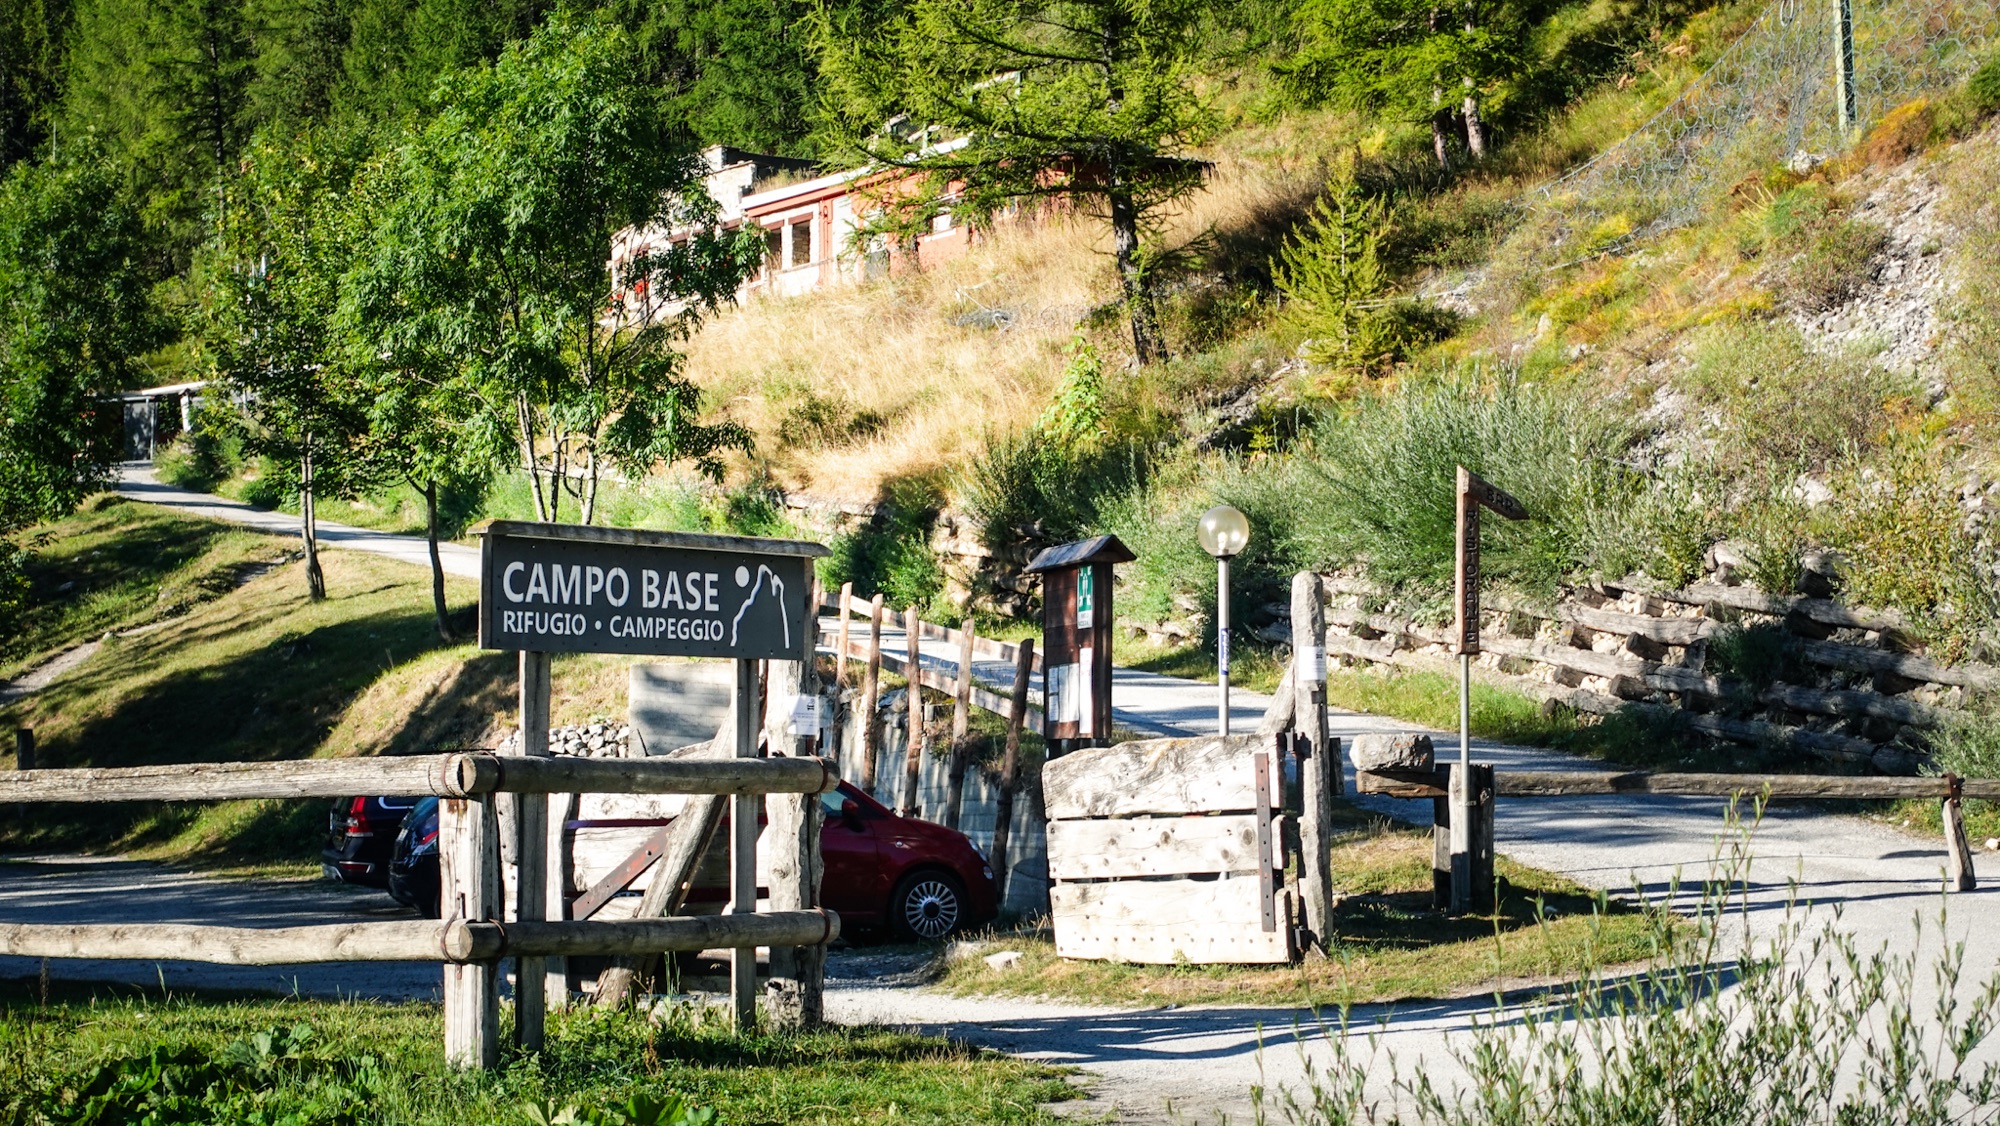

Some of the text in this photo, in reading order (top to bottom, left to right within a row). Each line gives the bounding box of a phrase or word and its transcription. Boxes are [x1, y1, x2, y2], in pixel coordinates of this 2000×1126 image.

[1487, 488, 1514, 513] BAR
[503, 561, 719, 611] CAMPO BASE
[1464, 510, 1478, 644] RISTORANTE
[503, 611, 724, 641] RIFUGIO CAMPEGGIO
